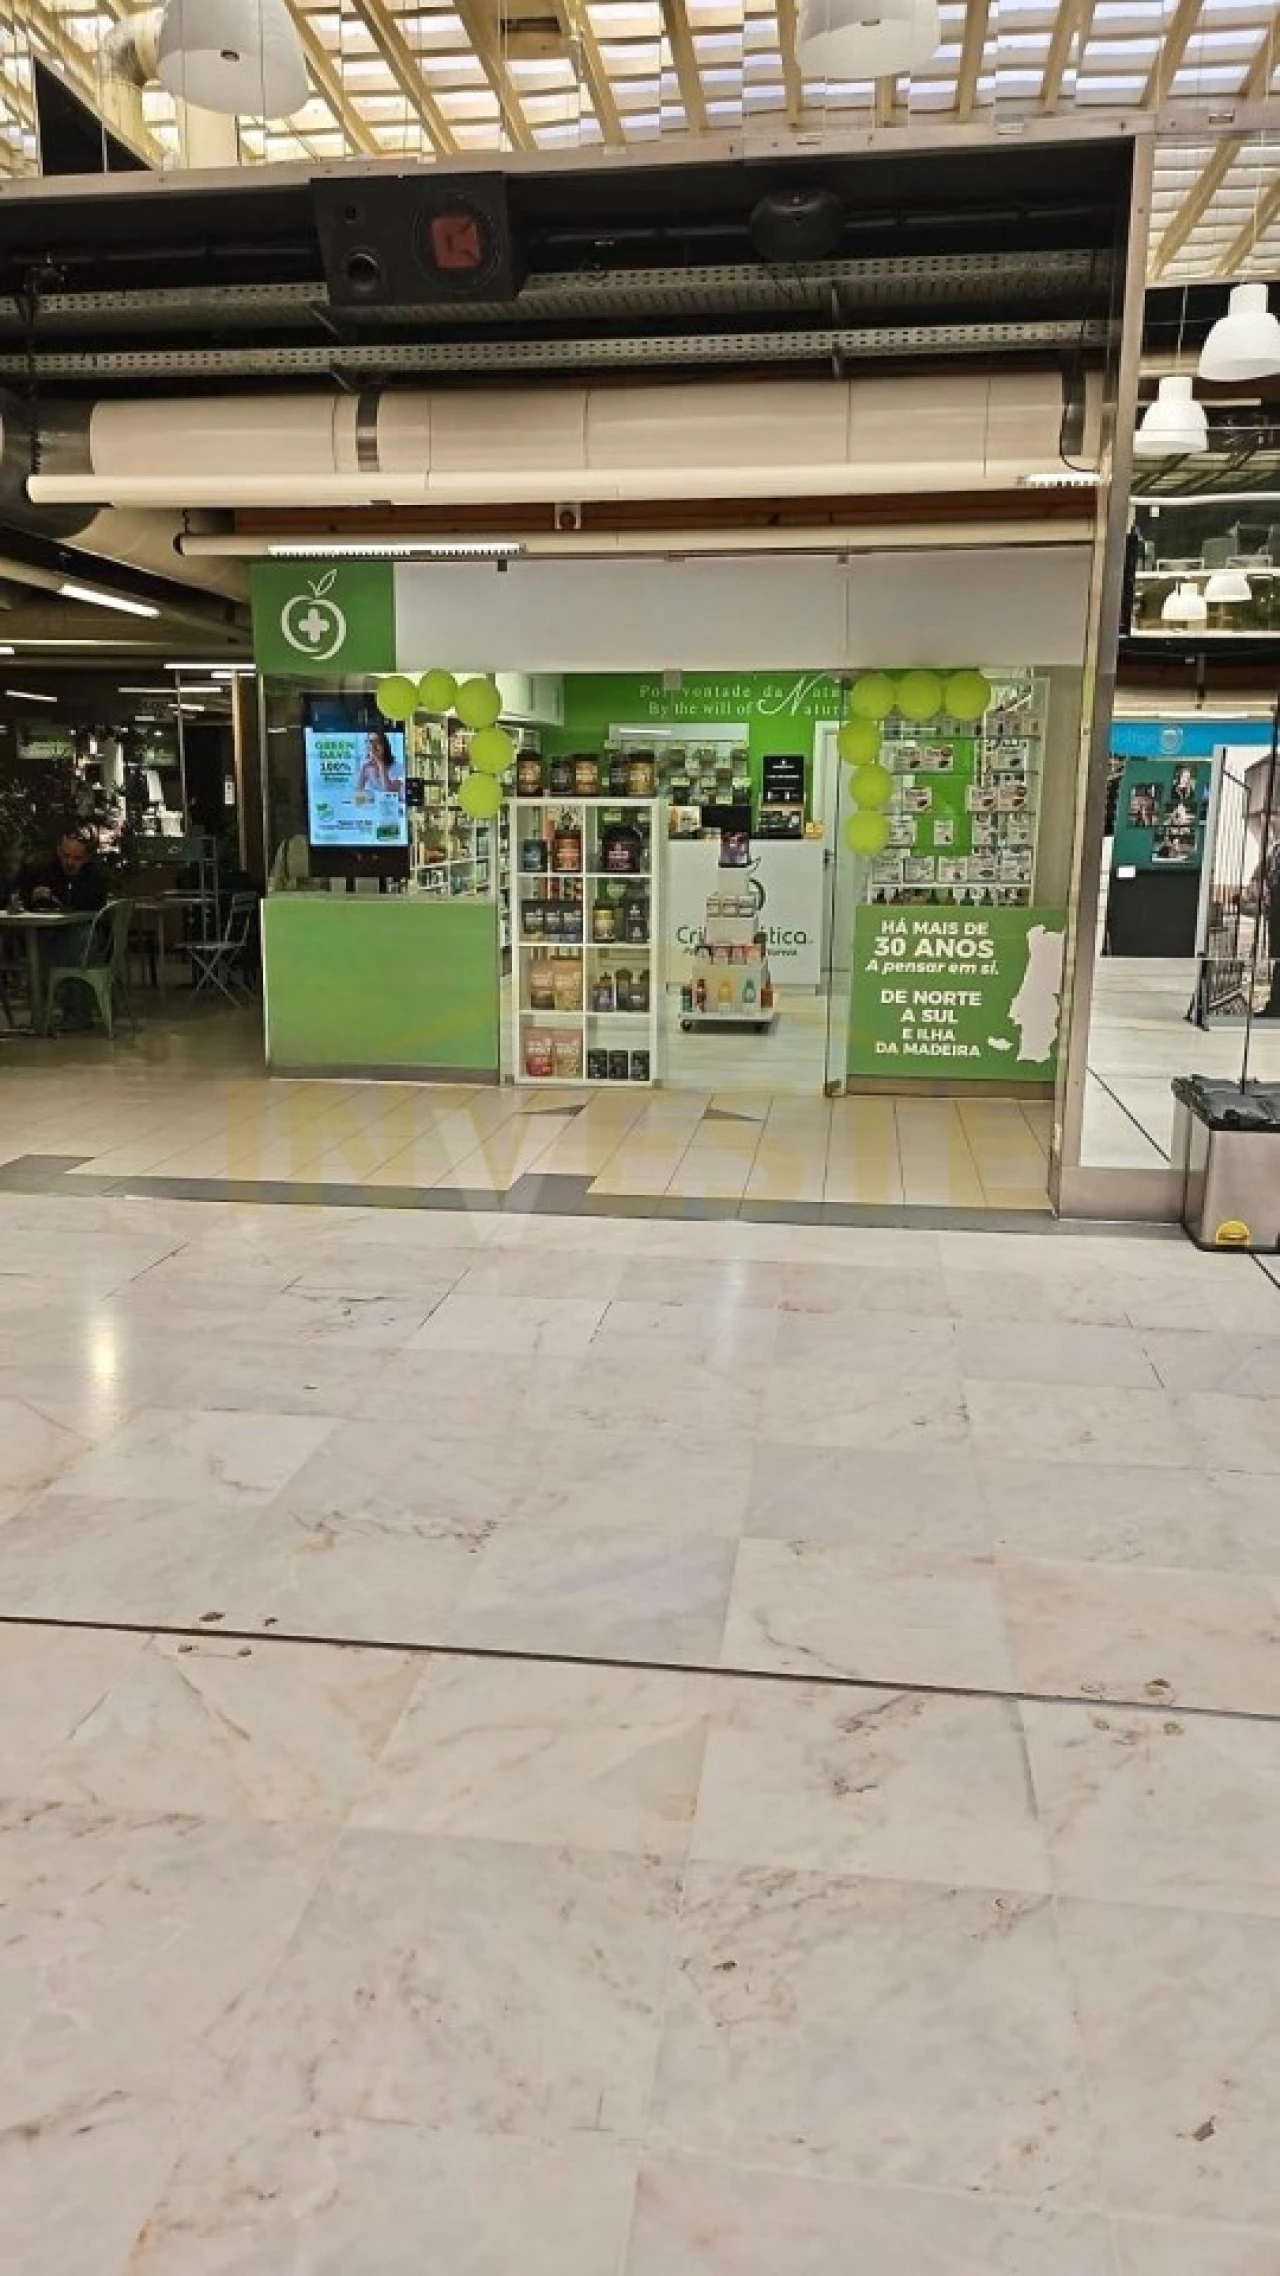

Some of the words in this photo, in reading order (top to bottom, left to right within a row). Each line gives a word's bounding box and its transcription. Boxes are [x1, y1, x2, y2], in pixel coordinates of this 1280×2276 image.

[682, 683, 750, 698] vontade
[762, 683, 783, 698] da
[649, 701, 669, 718] By
[674, 701, 698, 715] the
[703, 701, 731, 715] will
[736, 701, 753, 715] of
[881, 917, 908, 935] HÁ
[912, 921, 959, 935] MAIS
[964, 921, 989, 935] DE
[874, 936, 907, 957] 30
[914, 938, 995, 959] ANOS
[865, 959, 878, 972] A
[881, 962, 946, 976] pensar
[948, 962, 977, 975] em
[881, 988, 908, 1004] DE
[913, 990, 983, 1006] NORTE
[900, 1007, 916, 1023] A
[921, 1009, 959, 1024] SUL
[902, 1028, 913, 1039] E
[917, 1029, 956, 1041] ILHA
[875, 1041, 899, 1054] DA
[902, 1043, 982, 1057] MADEIRA
